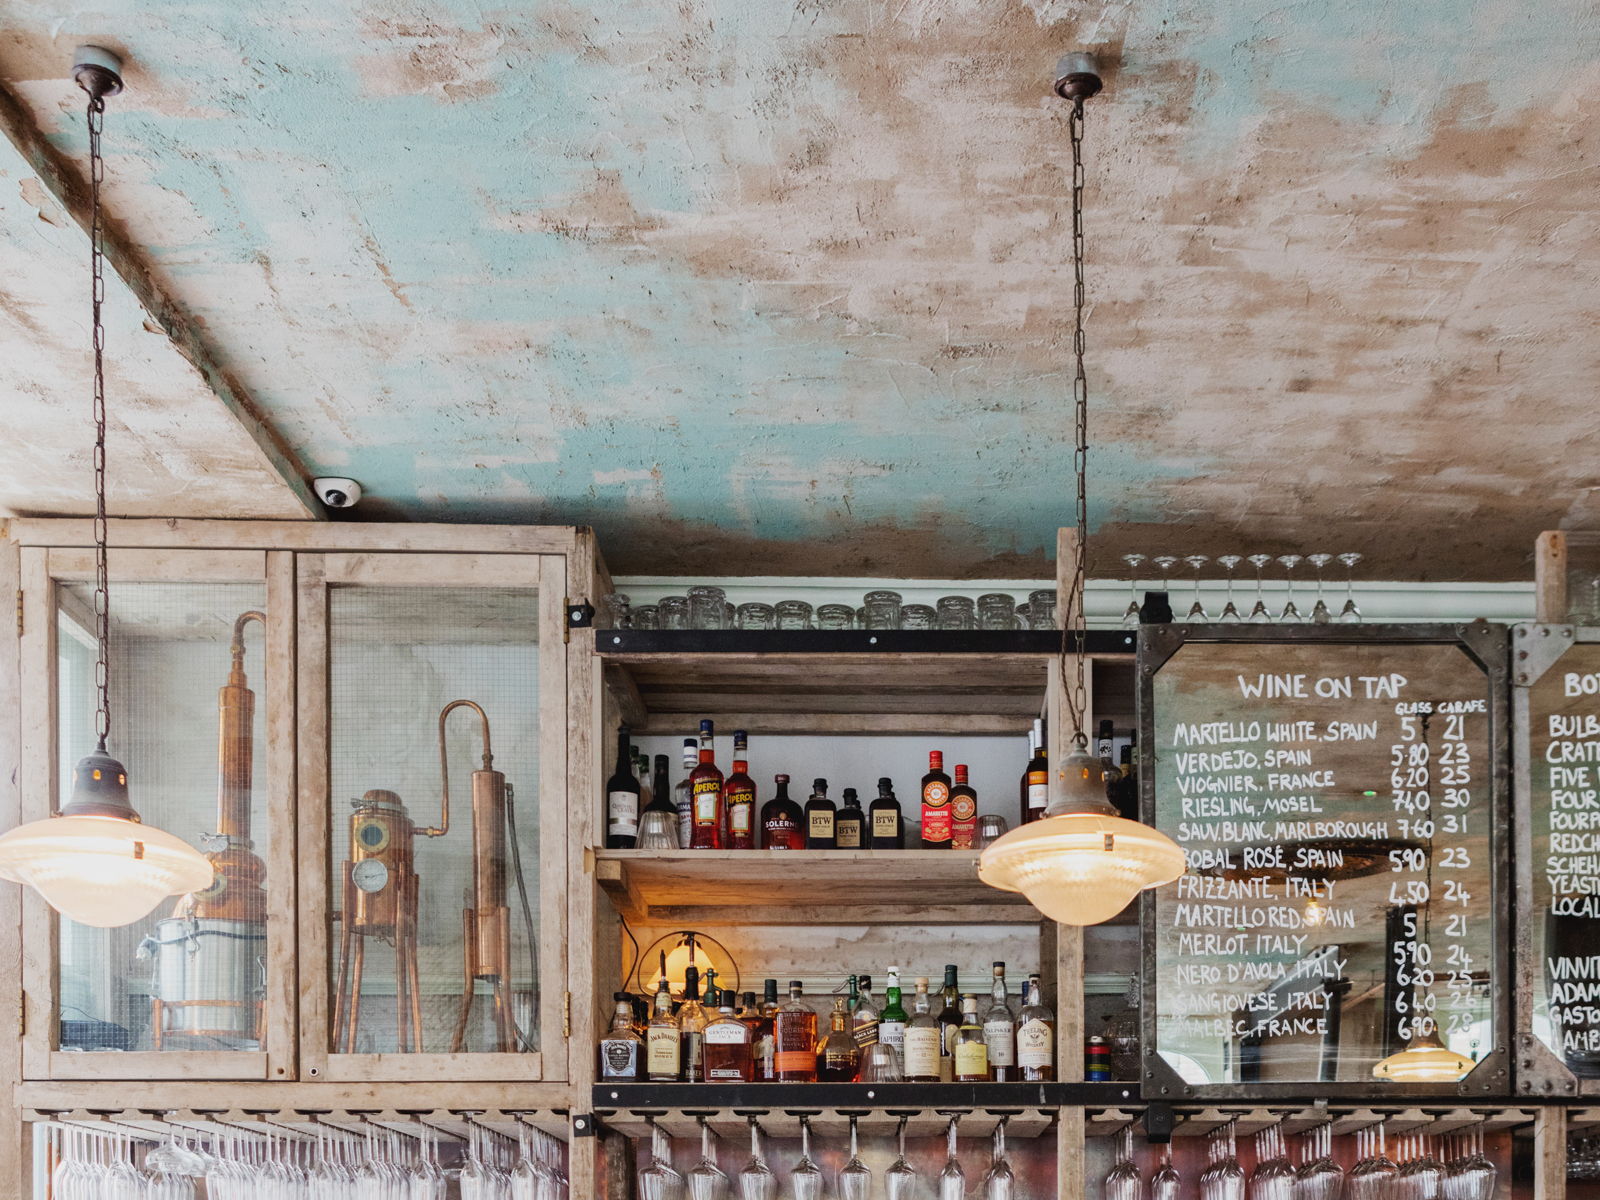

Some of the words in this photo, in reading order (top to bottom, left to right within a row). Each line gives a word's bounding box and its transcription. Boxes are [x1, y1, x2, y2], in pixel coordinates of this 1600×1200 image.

[1237, 673, 1309, 699] WINE
[1314, 676, 1352, 699] ON
[1358, 673, 1408, 699] TAP
[1395, 701, 1433, 716] GLASS
[1437, 699, 1488, 714] CARAFE
[1173, 721, 1261, 746] MARTELLO
[1323, 720, 1377, 742] SPAIN
[1400, 716, 1416, 742] 5
[1442, 714, 1465, 741] 21
[1263, 748, 1312, 769] SPAIN
[1438, 742, 1471, 765] 23
[1267, 770, 1336, 792] FRANCE
[1440, 764, 1471, 785] 25
[1549, 766, 1591, 789] FIVE
[693, 782, 721, 795] APEROL
[728, 793, 754, 805] APEROL
[1262, 795, 1323, 815] MOSEL
[1440, 788, 1471, 808] 30
[1551, 789, 1600, 811] FOUR
[765, 820, 799, 828] SOLERNO
[811, 816, 832, 825] BTW
[838, 826, 858, 834] BTW
[875, 815, 896, 824] BTW
[1441, 813, 1467, 834] 31
[1180, 847, 1237, 870] BOBAL
[1293, 847, 1344, 869] SPAIN
[1438, 847, 1471, 869] 23
[1545, 854, 1600, 875] SCHEH
[1285, 877, 1336, 900] ITALY
[1443, 880, 1471, 907] 24
[1174, 903, 1266, 929] MARTELLO
[1304, 906, 1355, 929] SPAIN
[1403, 912, 1417, 938] 5
[1444, 914, 1467, 937] 21
[1256, 933, 1308, 955] ITALY
[1446, 944, 1473, 971] 24
[1176, 964, 1221, 986] NERO
[1296, 958, 1347, 981] ITALY
[1446, 969, 1473, 989] 25
[1287, 991, 1334, 1011] ITALY
[1450, 991, 1477, 1009] 26
[1257, 1017, 1329, 1038] FRANCE
[1445, 1012, 1474, 1036] 28
[1549, 1005, 1600, 1026] GASTO
[650, 1034, 661, 1043] JACK
[853, 1032, 867, 1040] BLACK
[1022, 1027, 1048, 1037] TEELING
